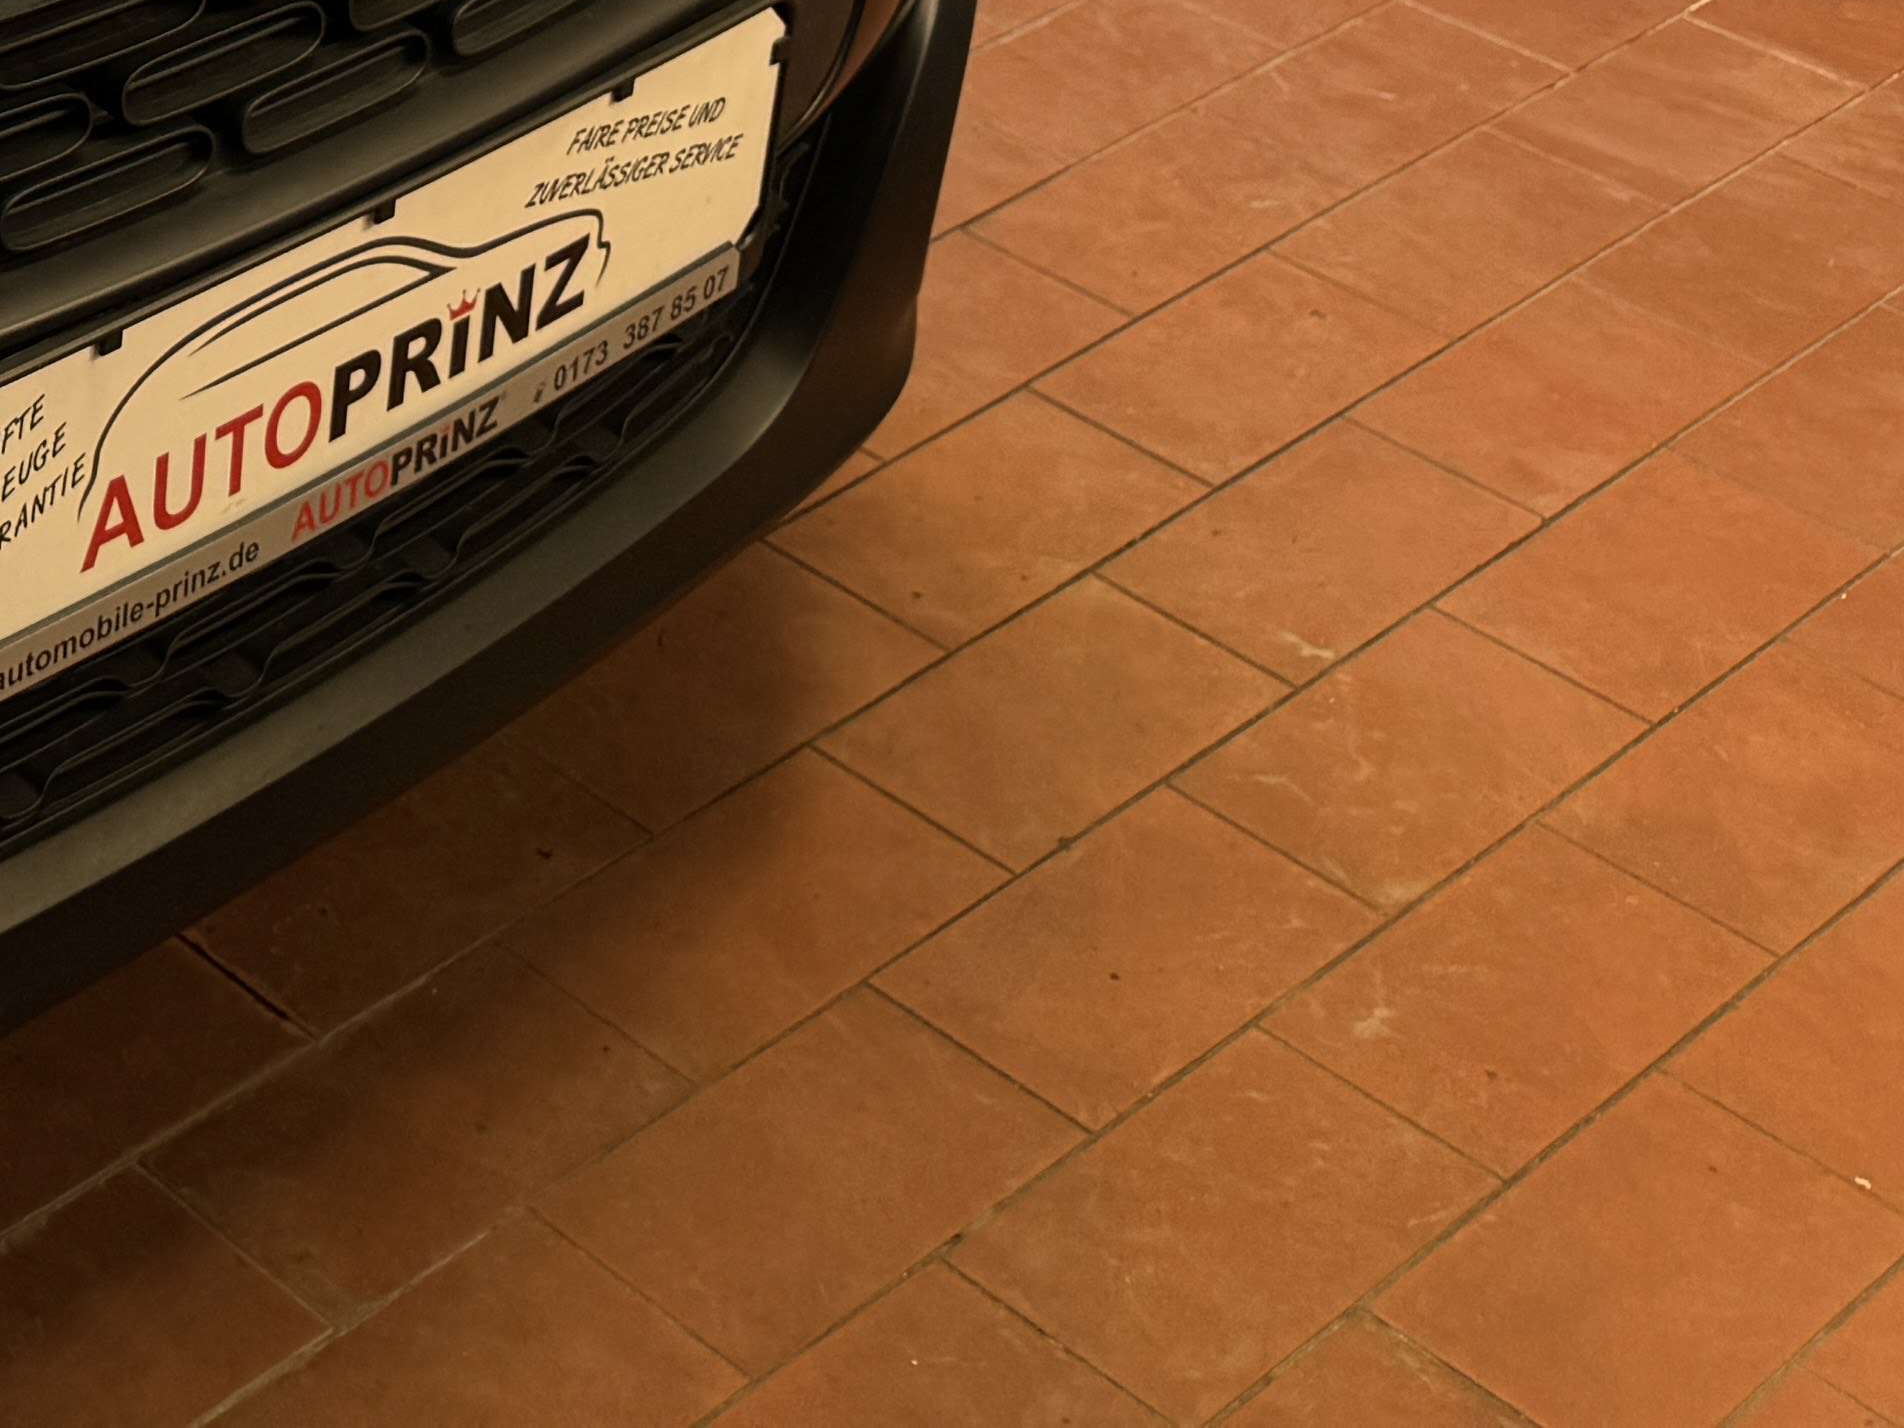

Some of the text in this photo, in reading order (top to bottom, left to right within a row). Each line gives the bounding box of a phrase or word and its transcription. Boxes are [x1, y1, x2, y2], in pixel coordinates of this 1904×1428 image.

[566, 96, 727, 156] FAIRE PREISE UND
[524, 133, 744, 209] ZUVERLÄSSIGER SERVICE
[553, 340, 609, 391] 0173
[622, 304, 665, 349] 387
[670, 286, 697, 321] 85
[703, 266, 730, 300] 07
